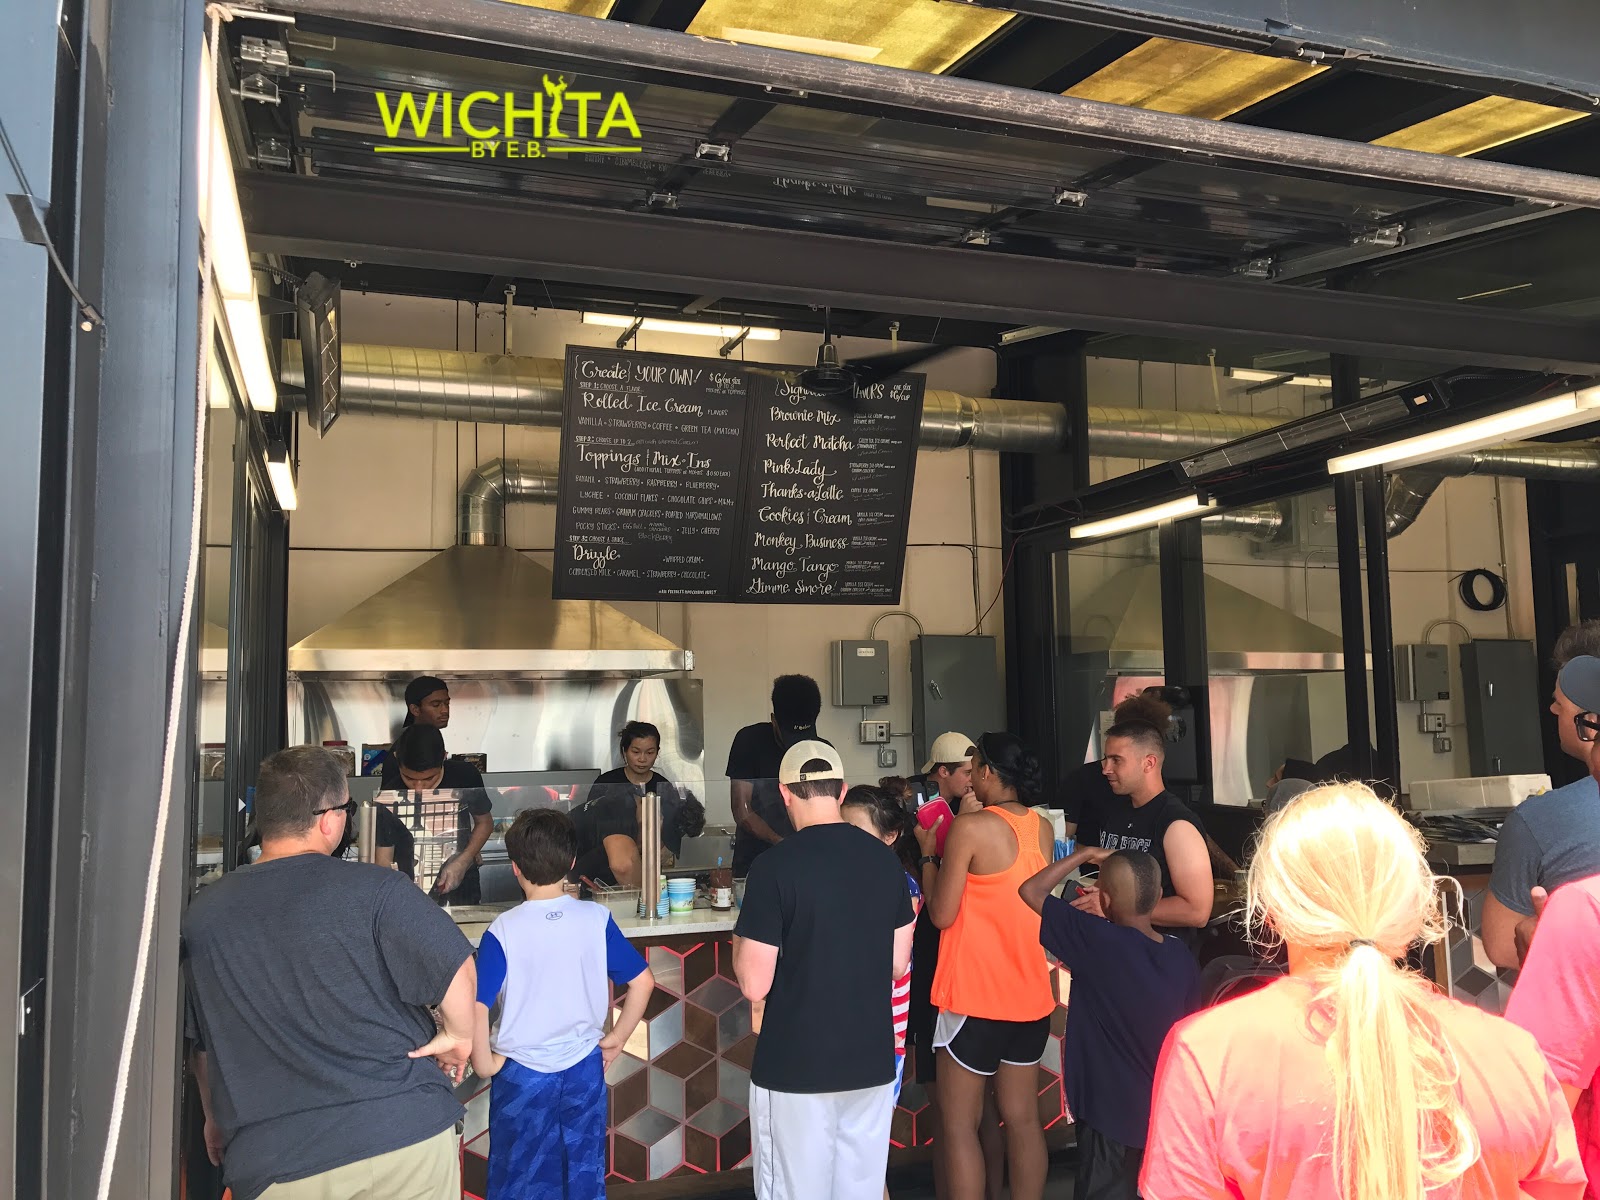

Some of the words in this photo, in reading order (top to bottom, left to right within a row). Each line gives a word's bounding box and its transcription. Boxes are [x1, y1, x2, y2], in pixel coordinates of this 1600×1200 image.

[634, 365, 667, 384] YOUR
[669, 369, 703, 386] OWN!
[600, 383, 617, 391] CHOOSE
[582, 392, 633, 410] Rolled
[637, 394, 662, 413] Ice
[664, 398, 704, 417] Cream
[578, 416, 604, 427] VANILLA
[608, 418, 647, 430] STRAWBERRY
[652, 422, 673, 432] COFFEE
[681, 425, 698, 433] GREEN
[701, 426, 712, 434] TEA
[769, 406, 815, 423] Brownie
[816, 410, 841, 426] Mix
[765, 433, 811, 450] Perfect
[813, 434, 855, 452] Matcha
[577, 444, 641, 473] Toppings
[575, 475, 595, 484] BANANA
[604, 476, 641, 487] STRAWBERRY
[646, 479, 678, 489] RASPBERRY
[685, 481, 718, 491] BLUEBERRY
[580, 491, 604, 500] LYCHEE
[614, 493, 639, 501] COCONUT
[640, 494, 658, 503] FLAKES
[667, 496, 696, 505] CHOCOLATE
[697, 497, 713, 505] CHIPS
[572, 506, 593, 515] GUMMY
[595, 507, 612, 516] BEARS
[616, 509, 637, 518] GRAHAM
[637, 509, 662, 519] CRACKERS
[685, 512, 722, 521] MARSHMALLOWS
[758, 506, 804, 526] Cookies
[813, 508, 853, 526] Cream
[575, 522, 595, 531] POCKY
[596, 522, 618, 532] STICKS
[682, 527, 696, 535] JELLY
[700, 527, 721, 536] CHERRY
[754, 532, 804, 556] Monkey
[805, 534, 850, 549] Business
[572, 544, 621, 570] Drizzle
[665, 556, 685, 564] WHIPPED
[686, 556, 702, 564] CREAM
[568, 568, 598, 577] CONDENSED
[598, 568, 612, 577] MILK
[616, 569, 641, 579] CARAMEL
[646, 569, 677, 578] STRAWBERRY
[680, 570, 707, 579] CHOCOLATE
[751, 556, 798, 579] Mango
[799, 556, 840, 582] Tango
[746, 577, 791, 595] Gimme
